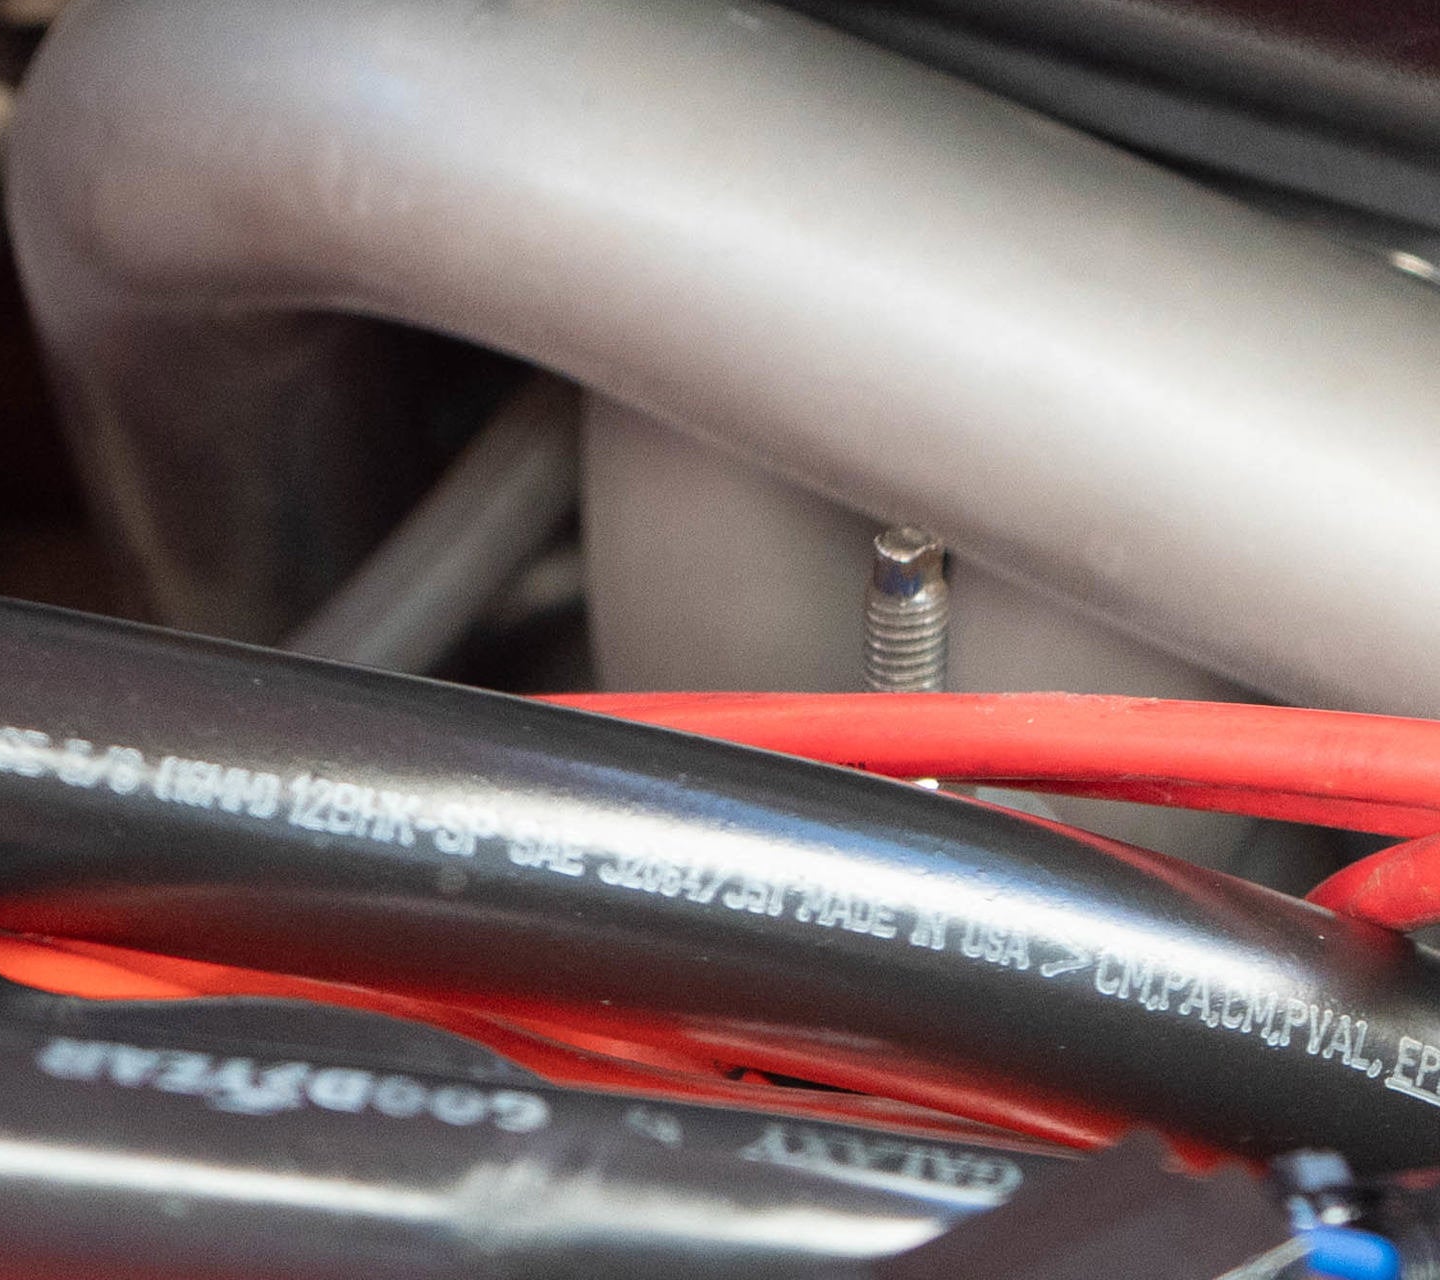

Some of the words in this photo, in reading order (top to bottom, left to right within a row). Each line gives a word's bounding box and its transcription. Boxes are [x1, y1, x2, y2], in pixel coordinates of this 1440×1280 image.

[792, 876, 905, 945] MADE
[906, 902, 955, 953] IN
[957, 913, 1039, 974] USA
[738, 1116, 1027, 1204] GALAXY
